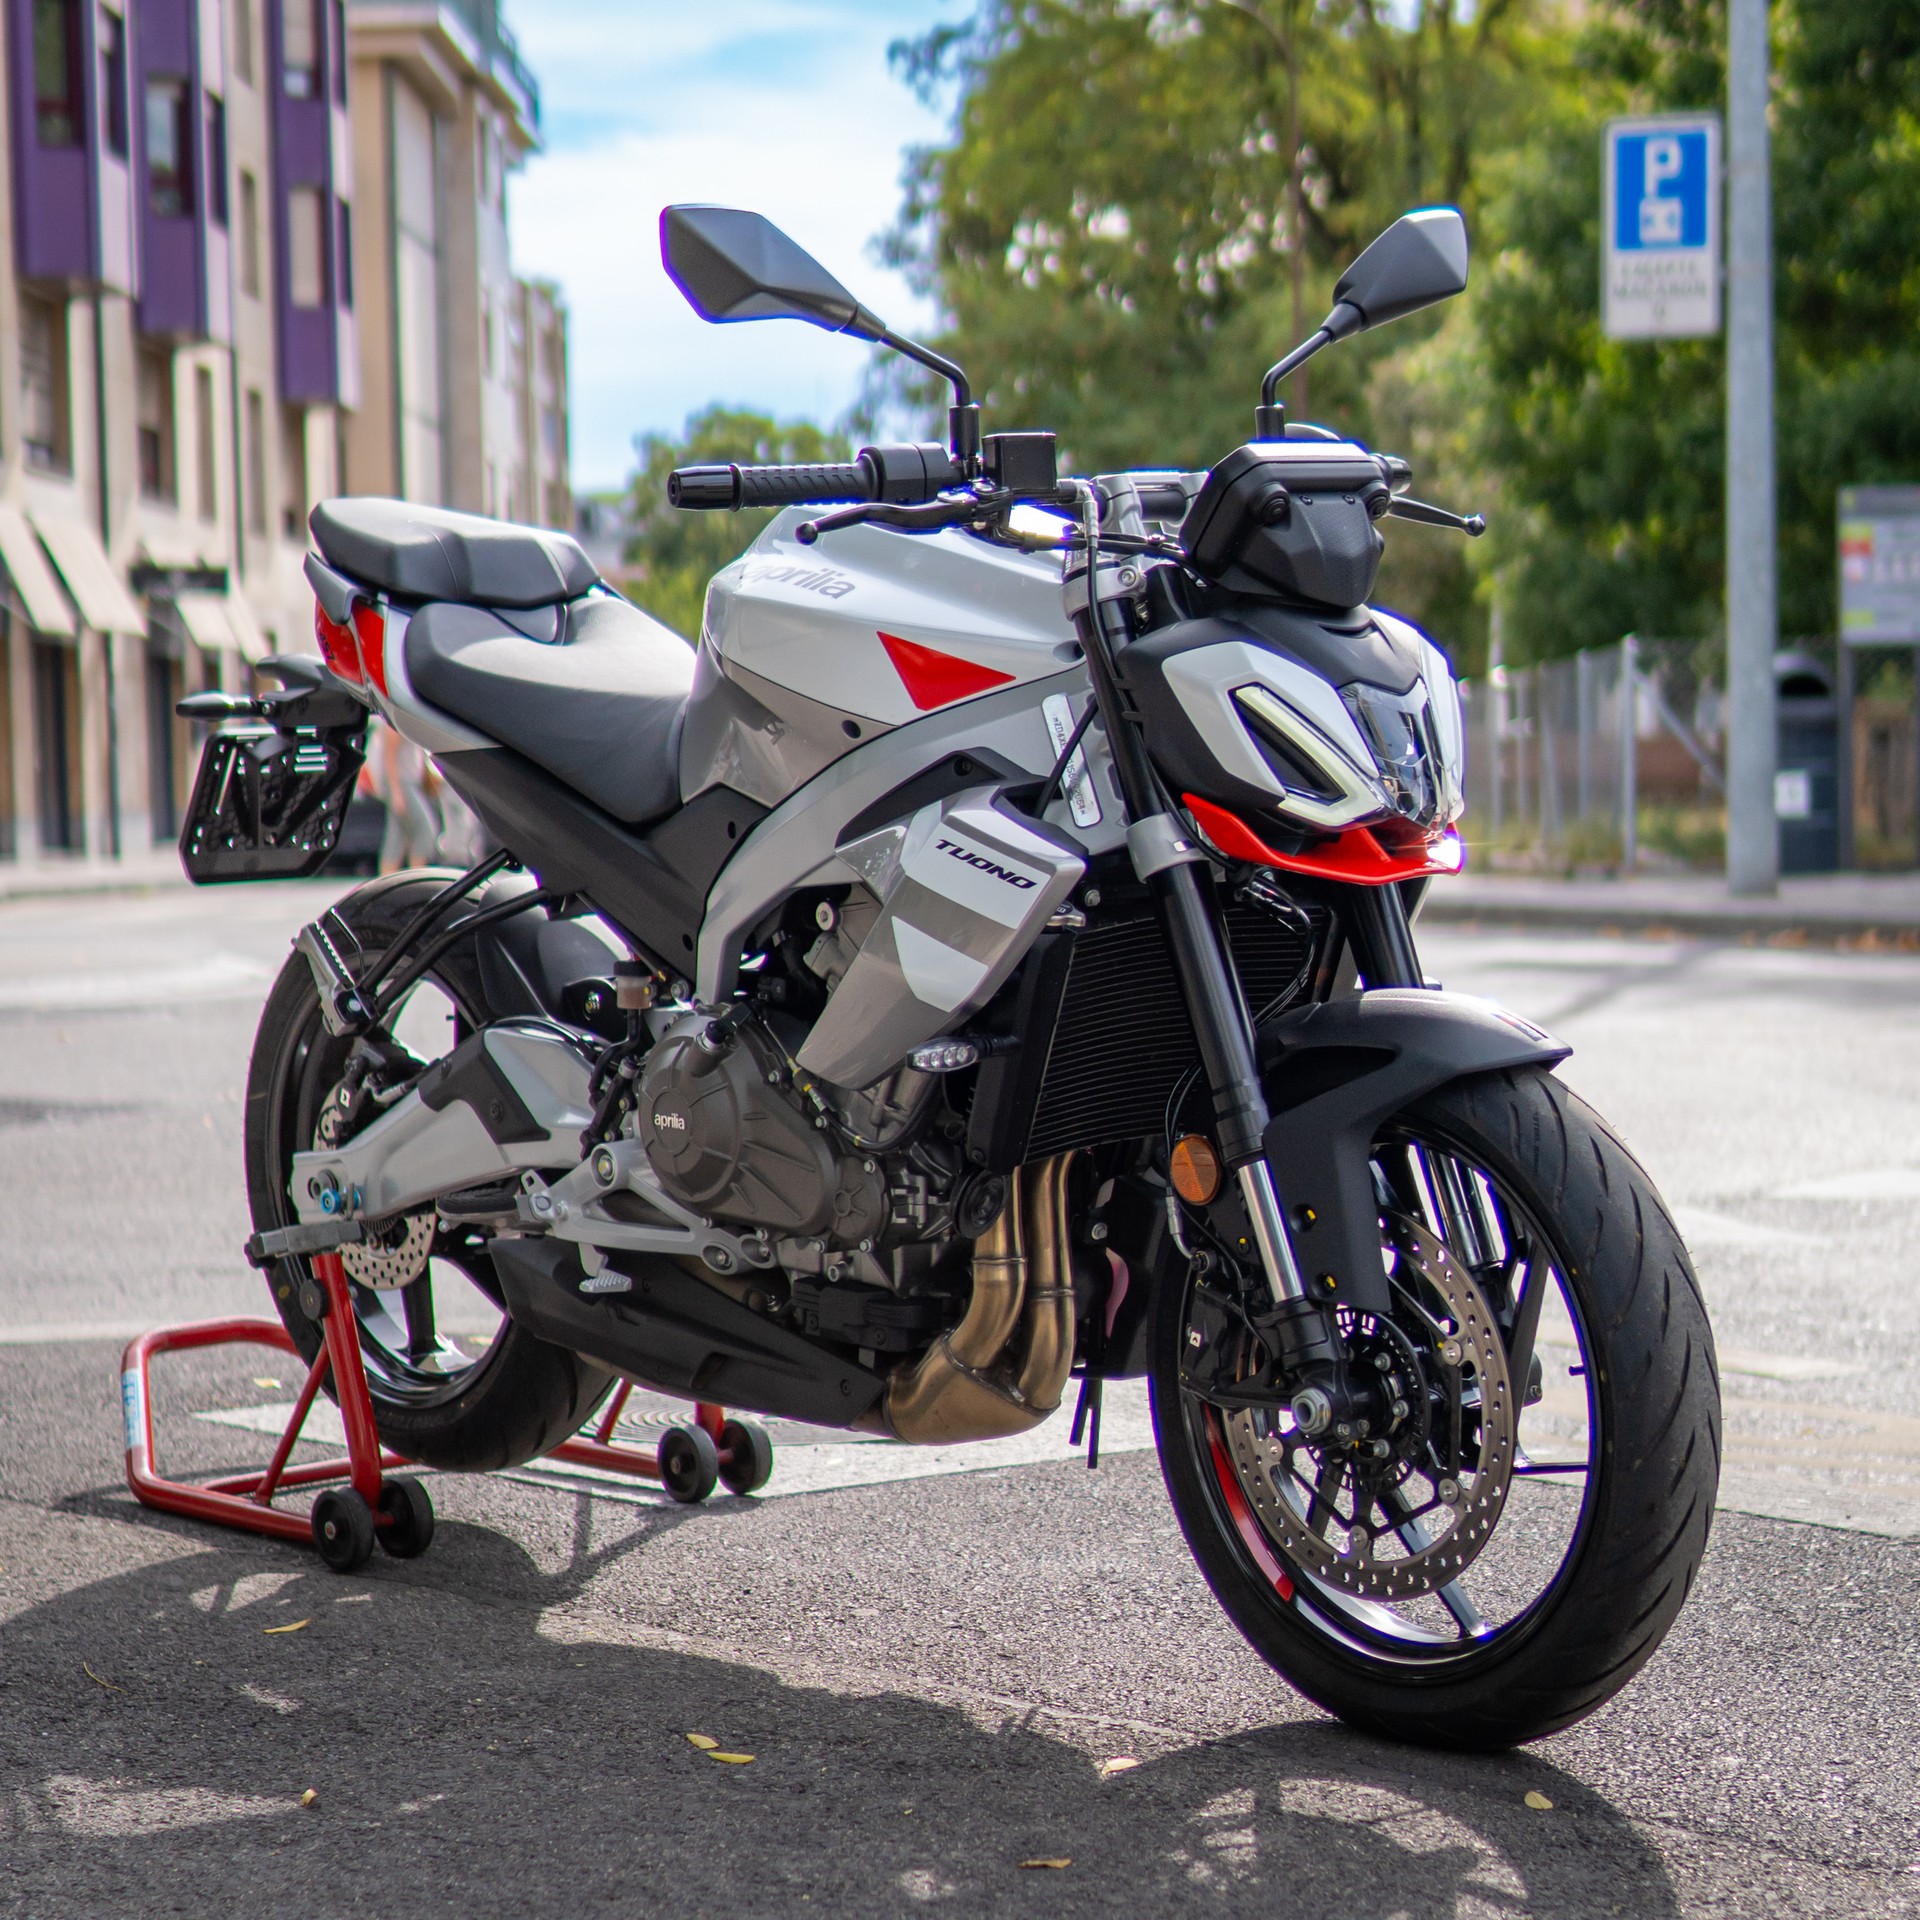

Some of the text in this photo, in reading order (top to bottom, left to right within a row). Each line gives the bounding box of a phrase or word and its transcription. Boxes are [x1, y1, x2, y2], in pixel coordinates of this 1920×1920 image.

[1643, 137, 1683, 196] P
[744, 564, 856, 600] aprilia
[935, 838, 1038, 890] TUONO
[654, 1112, 685, 1130] aprilia
